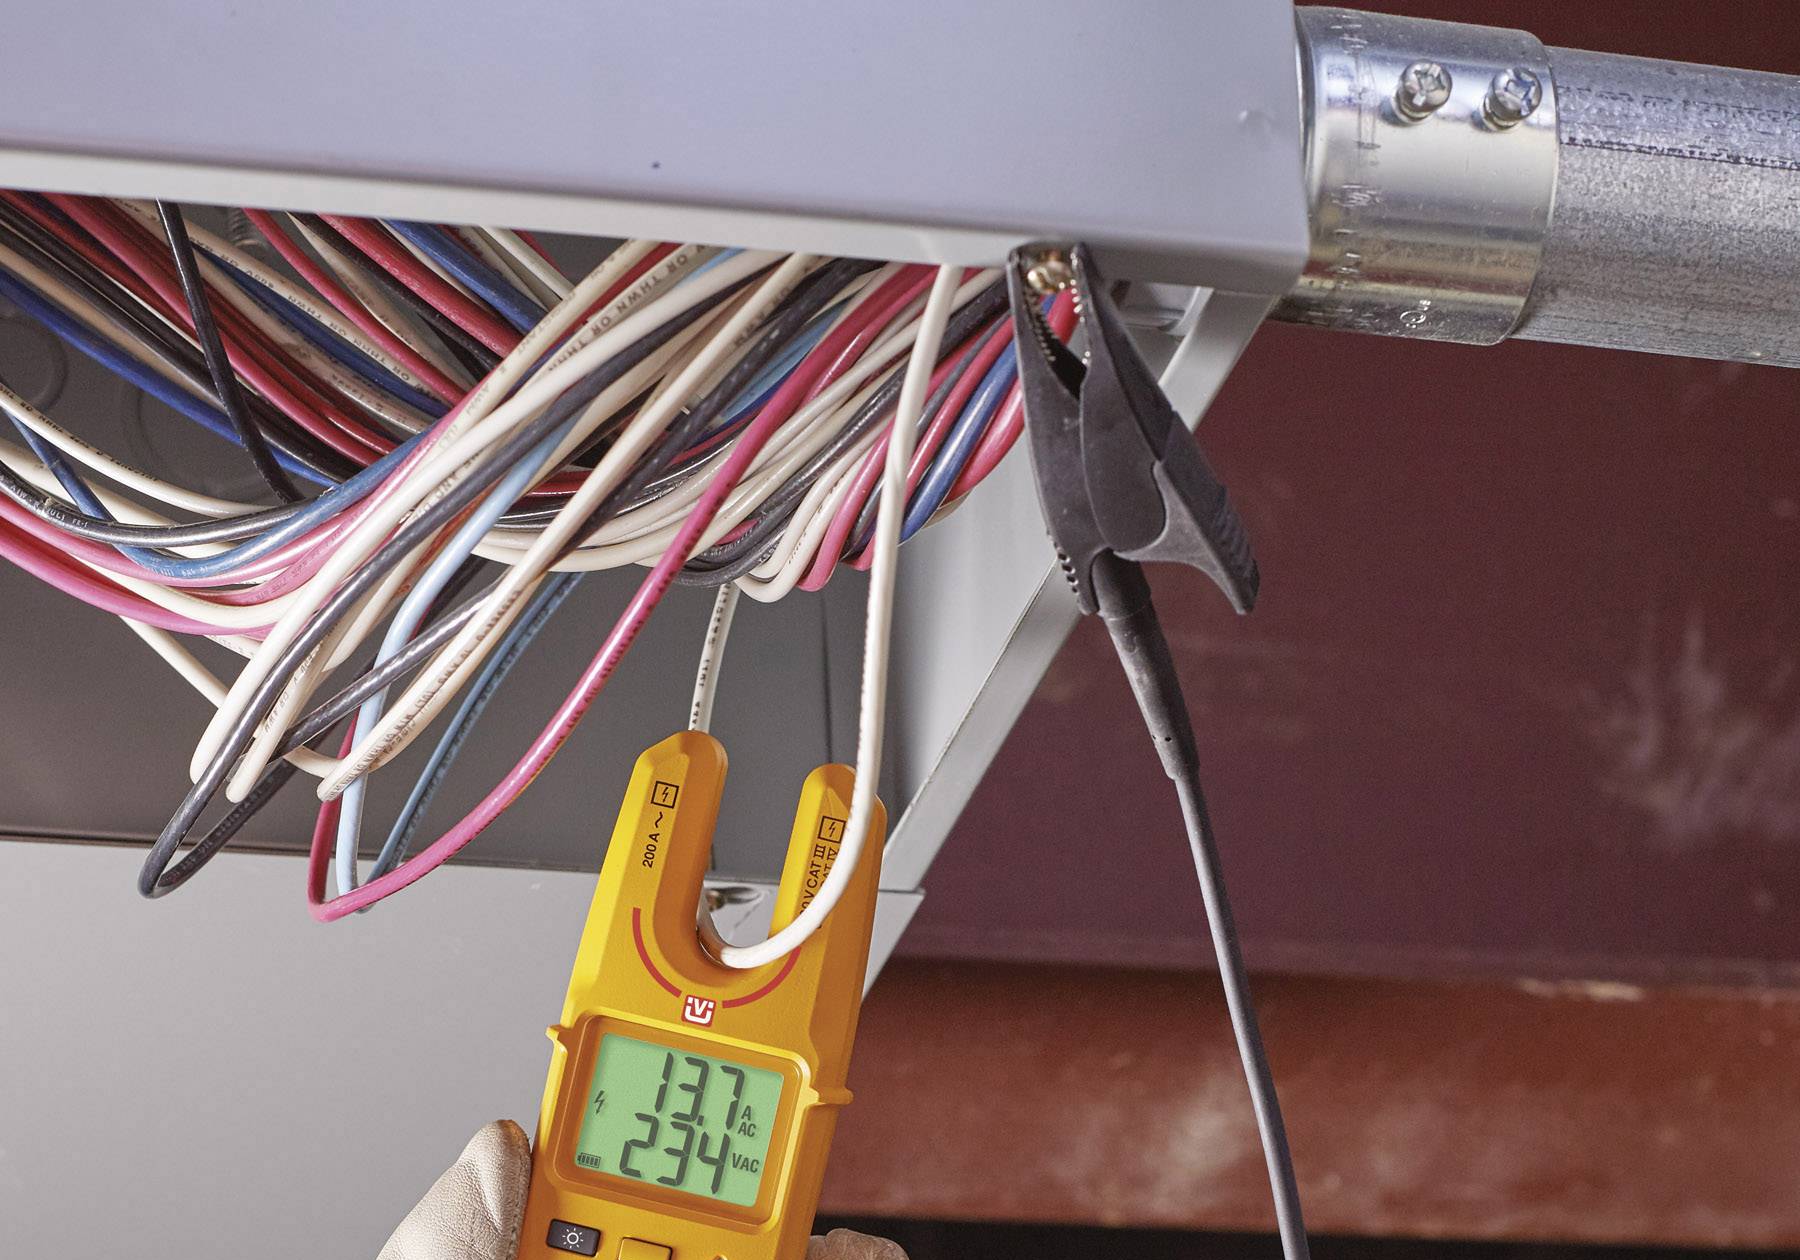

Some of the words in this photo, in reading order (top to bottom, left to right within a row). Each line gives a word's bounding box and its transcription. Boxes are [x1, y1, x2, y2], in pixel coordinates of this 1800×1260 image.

[665, 252, 689, 274] OR
[654, 1052, 745, 1131] 13.7
[741, 1105, 752, 1121] A
[619, 1112, 731, 1194] 234
[731, 1152, 760, 1174] VAC
[737, 1122, 758, 1138] AC
